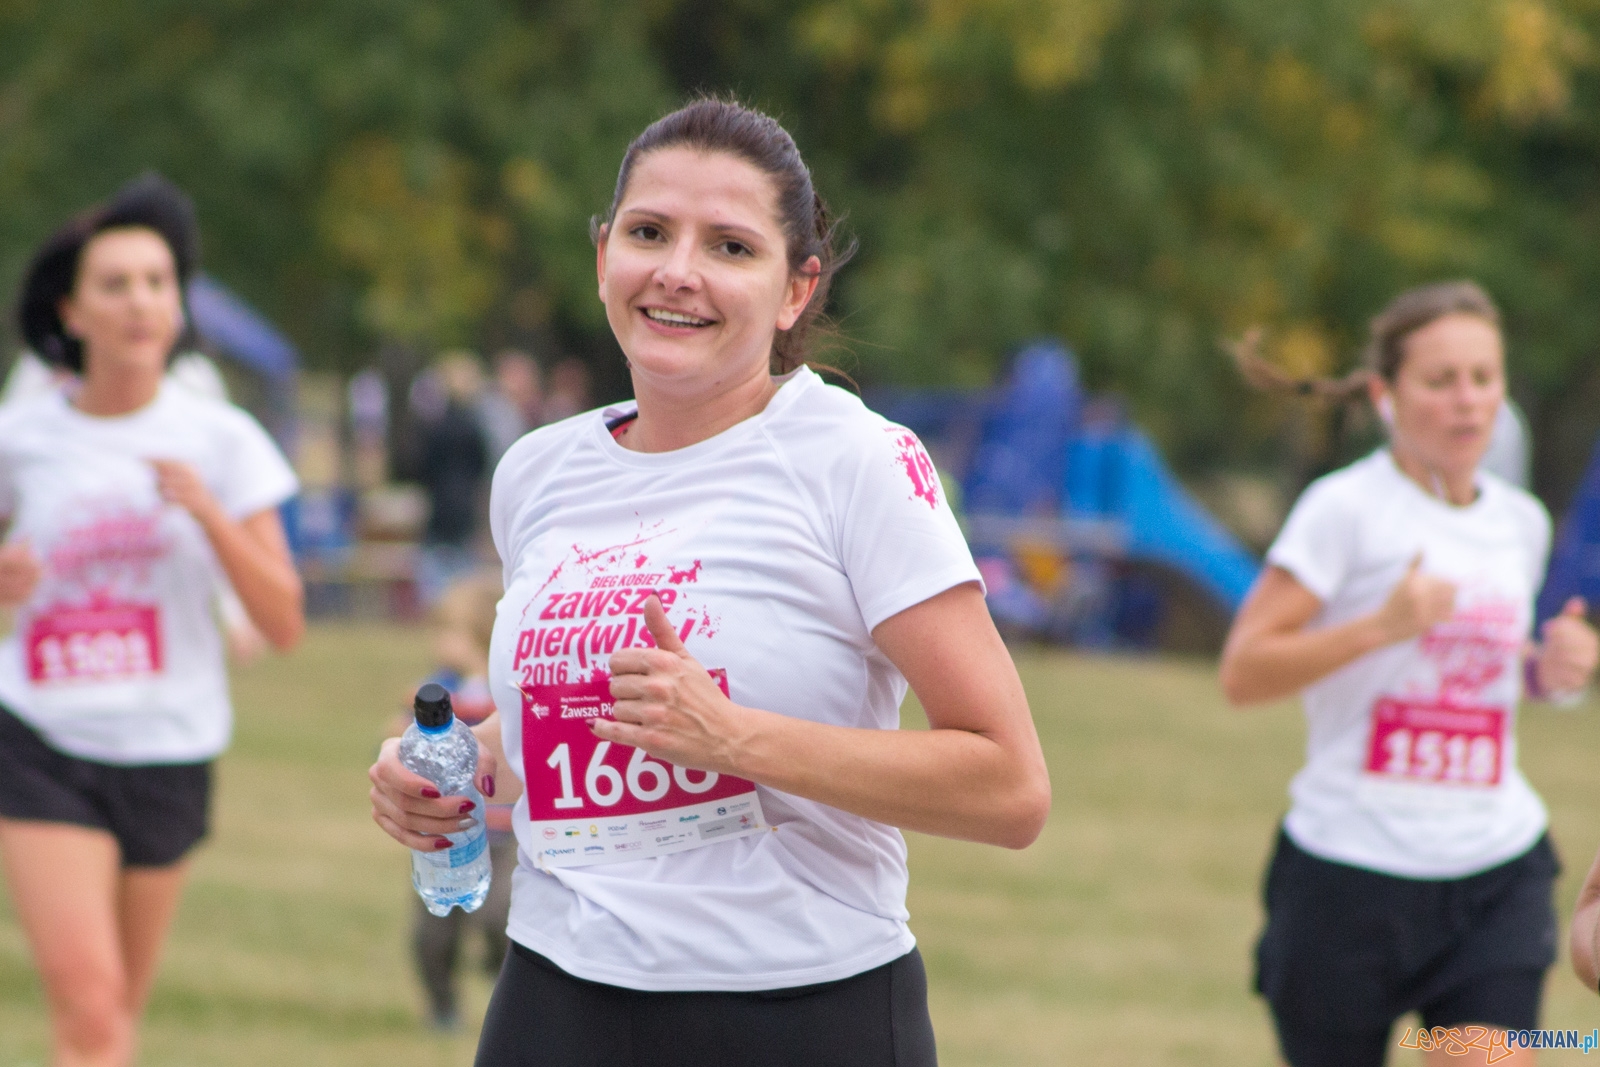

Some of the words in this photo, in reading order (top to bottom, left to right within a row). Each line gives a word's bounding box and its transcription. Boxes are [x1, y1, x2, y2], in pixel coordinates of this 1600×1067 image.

[590, 574, 617, 589] BIEG
[619, 573, 666, 587] KOBIET
[539, 588, 678, 620] zawsze
[513, 617, 697, 671] pier(w)s!
[521, 661, 568, 686] 2016
[561, 704, 599, 719] Zawsze
[601, 702, 614, 717] Pi
